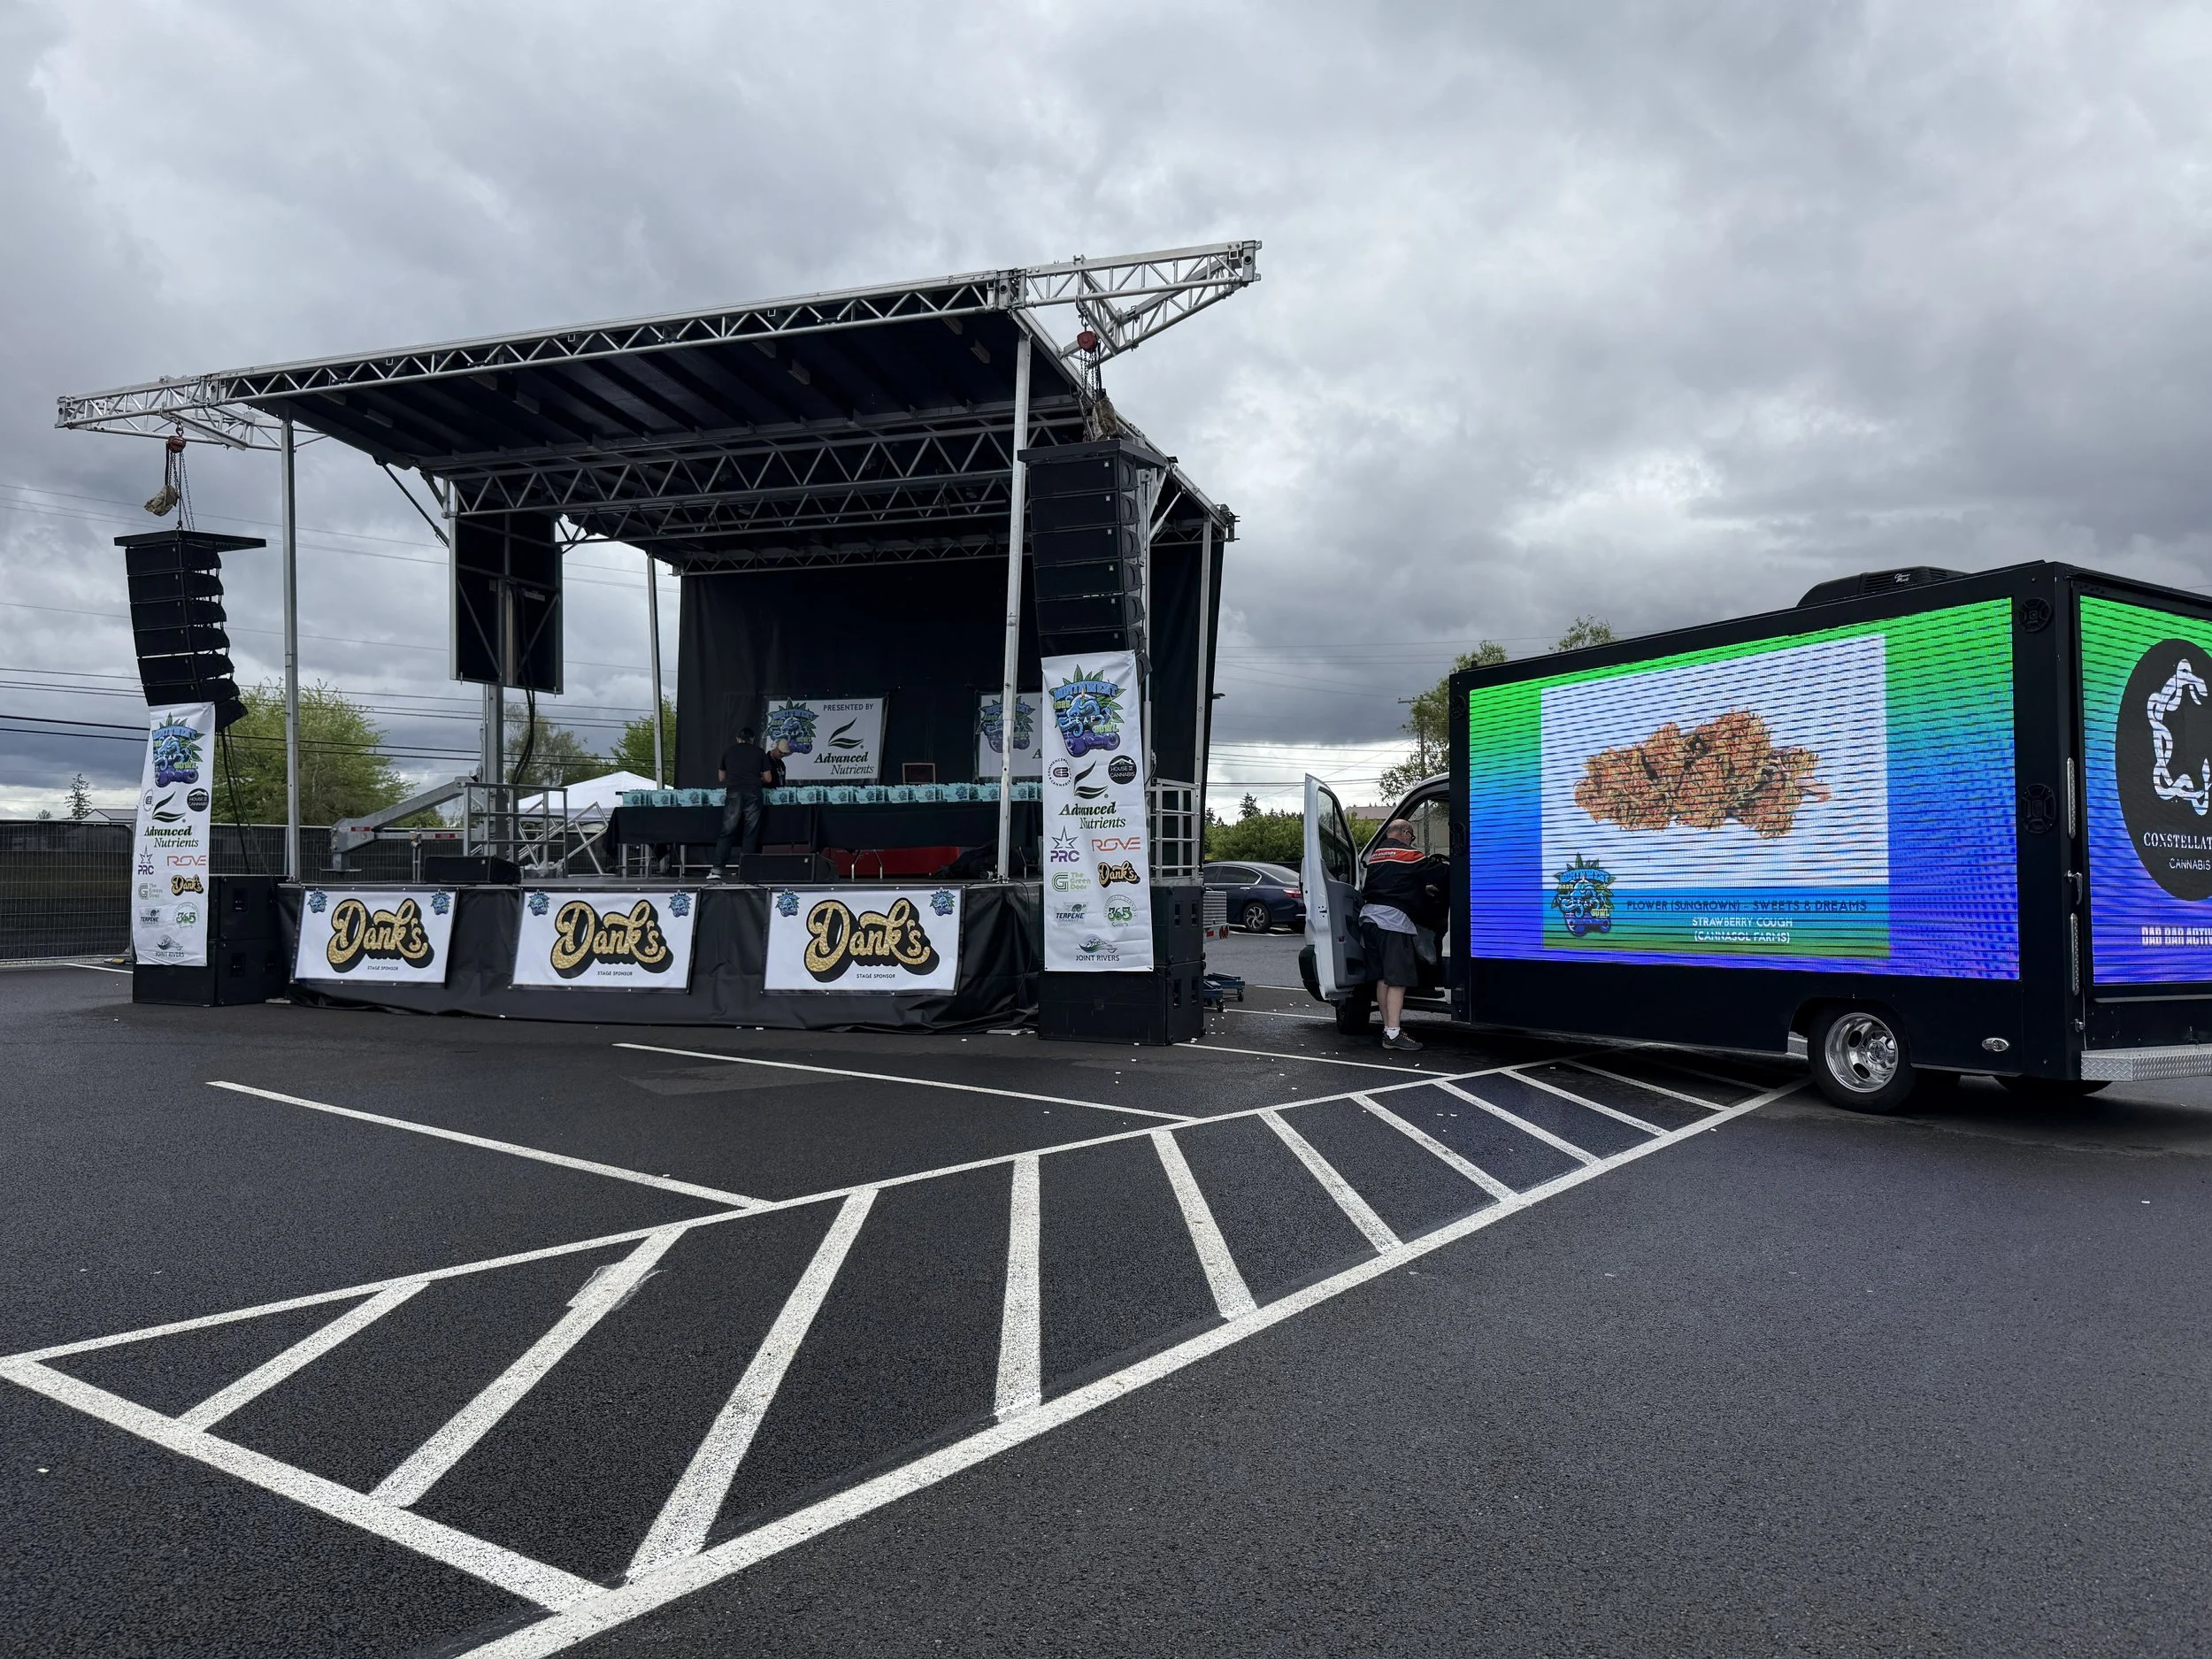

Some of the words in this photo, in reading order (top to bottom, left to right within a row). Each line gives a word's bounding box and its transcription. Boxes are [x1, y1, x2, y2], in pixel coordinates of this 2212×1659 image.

[1069, 715, 1096, 725] LEAF
[814, 751, 869, 764] Advanced
[831, 764, 875, 775] Nutrients
[1059, 801, 1117, 816] Advanced
[1079, 817, 1126, 830] Nutrients
[144, 826, 193, 836] Advanced
[154, 838, 199, 848] Nutrients
[1091, 837, 1141, 851] ROVE
[167, 856, 207, 866] ROVE
[1050, 850, 1080, 863] PRC
[138, 864, 155, 875] PRC
[2169, 857, 2211, 871] CANNABIS
[1098, 861, 1139, 887] Dank's
[171, 874, 204, 895] Dank's
[1753, 901, 1800, 910] SWEETS
[1815, 901, 1867, 910] DREAMS
[176, 912, 196, 923] 365
[1108, 907, 1133, 921] 365
[1692, 918, 1753, 926] STRAWBERRY
[1756, 918, 1793, 927] COUGH
[326, 898, 431, 969] Dank's
[550, 900, 670, 974] Dank's
[804, 898, 936, 978] Dank's
[1694, 931, 1751, 941] (CANNASOL
[1754, 932, 1790, 943] FARMS)
[2141, 926, 2162, 946] DAB
